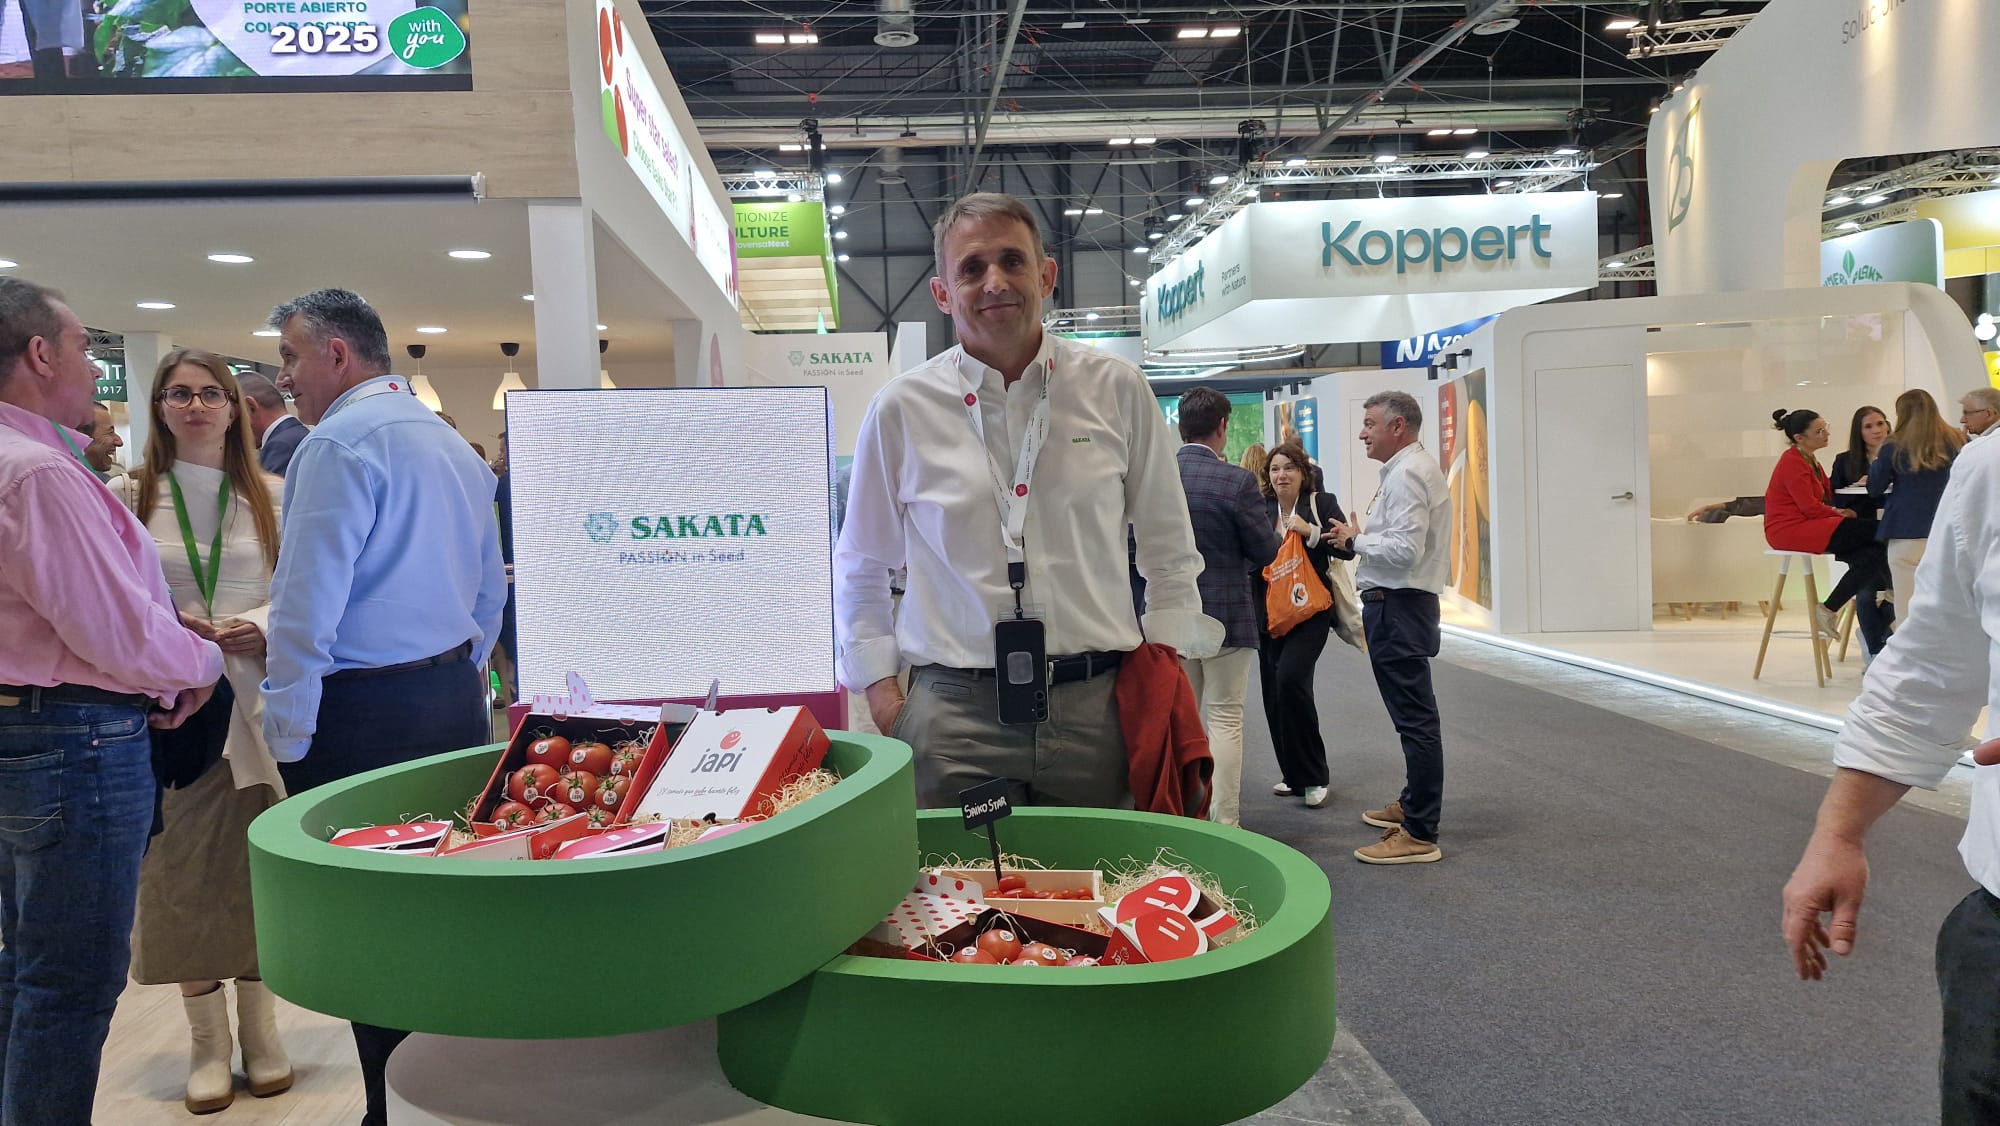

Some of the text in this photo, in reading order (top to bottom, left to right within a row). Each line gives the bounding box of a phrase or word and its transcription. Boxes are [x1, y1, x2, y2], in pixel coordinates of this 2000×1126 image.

[244, 2, 368, 13] PORTE ABIERTO
[408, 19, 441, 32] with
[271, 25, 379, 53] 2025
[403, 33, 445, 59] you
[1322, 214, 1552, 274] Koppert
[1158, 259, 1205, 322] Koppert
[810, 352, 873, 365] SAKATA
[96, 385, 122, 394] 1917
[631, 513, 767, 540] SAKATA
[708, 550, 745, 562] Seed
[690, 747, 748, 774] japi
